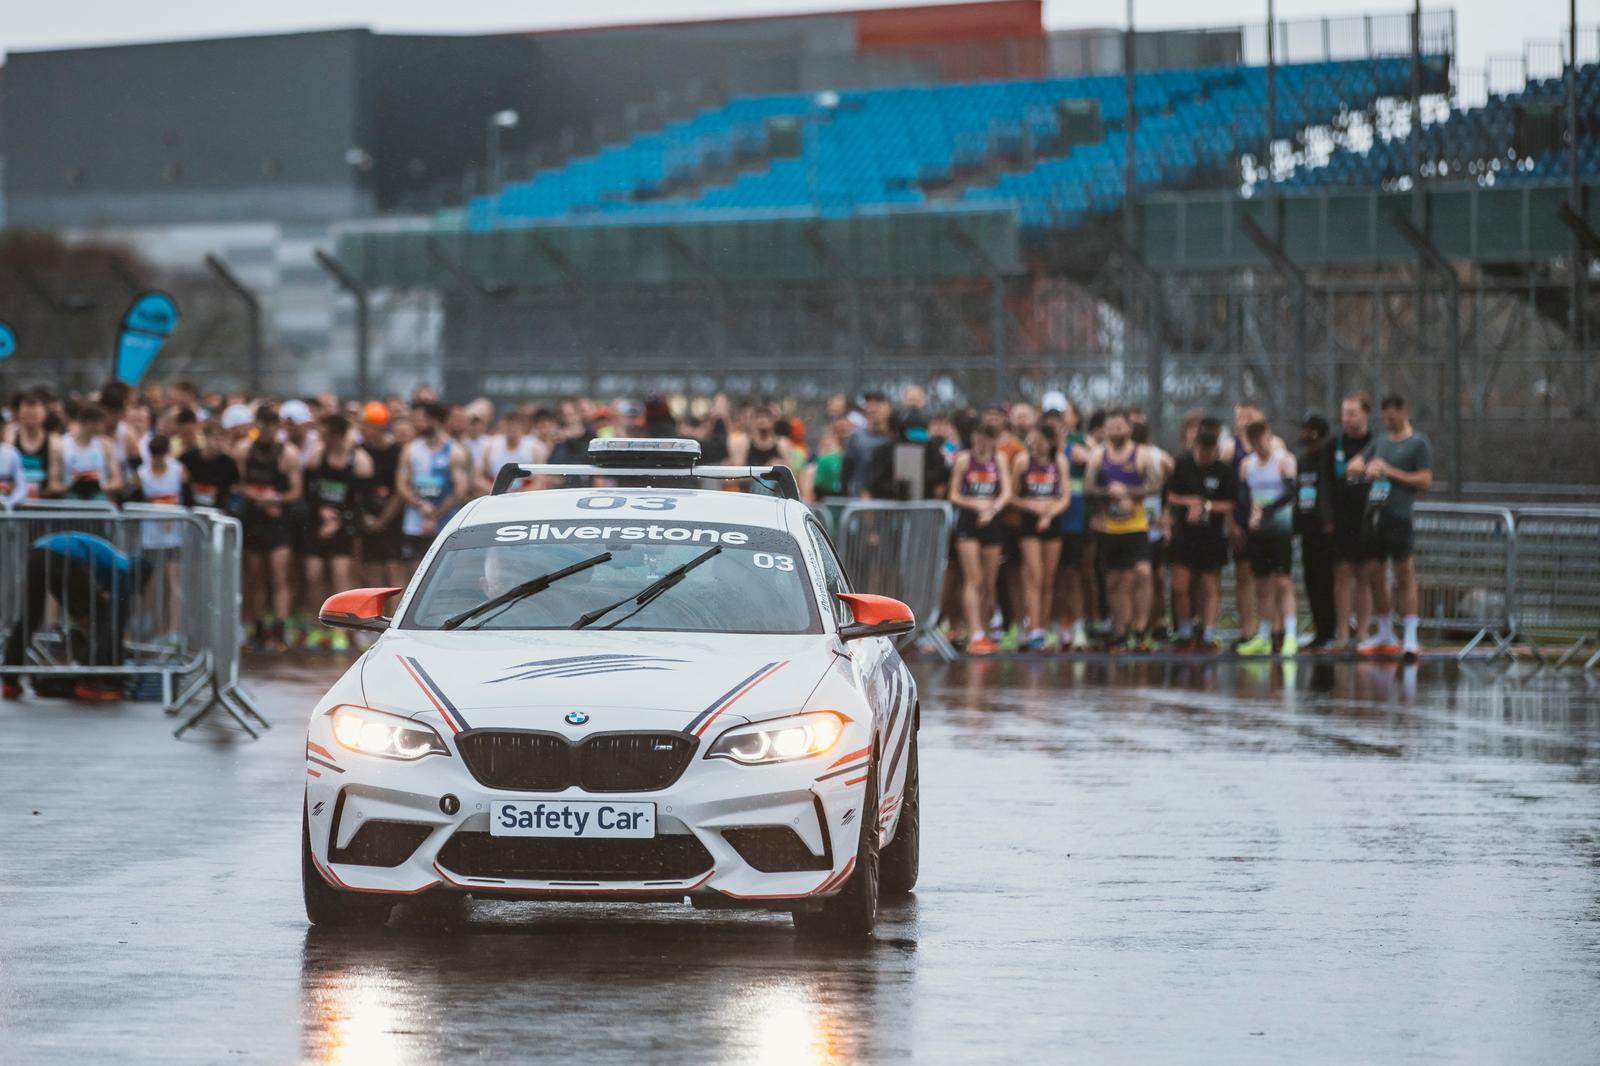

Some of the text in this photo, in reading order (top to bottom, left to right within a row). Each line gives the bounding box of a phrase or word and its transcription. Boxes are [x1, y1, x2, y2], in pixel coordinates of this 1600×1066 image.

[576, 496, 678, 511] 03
[495, 524, 750, 546] Silverstone
[753, 553, 795, 572] 03
[501, 804, 644, 836] Safety Car
